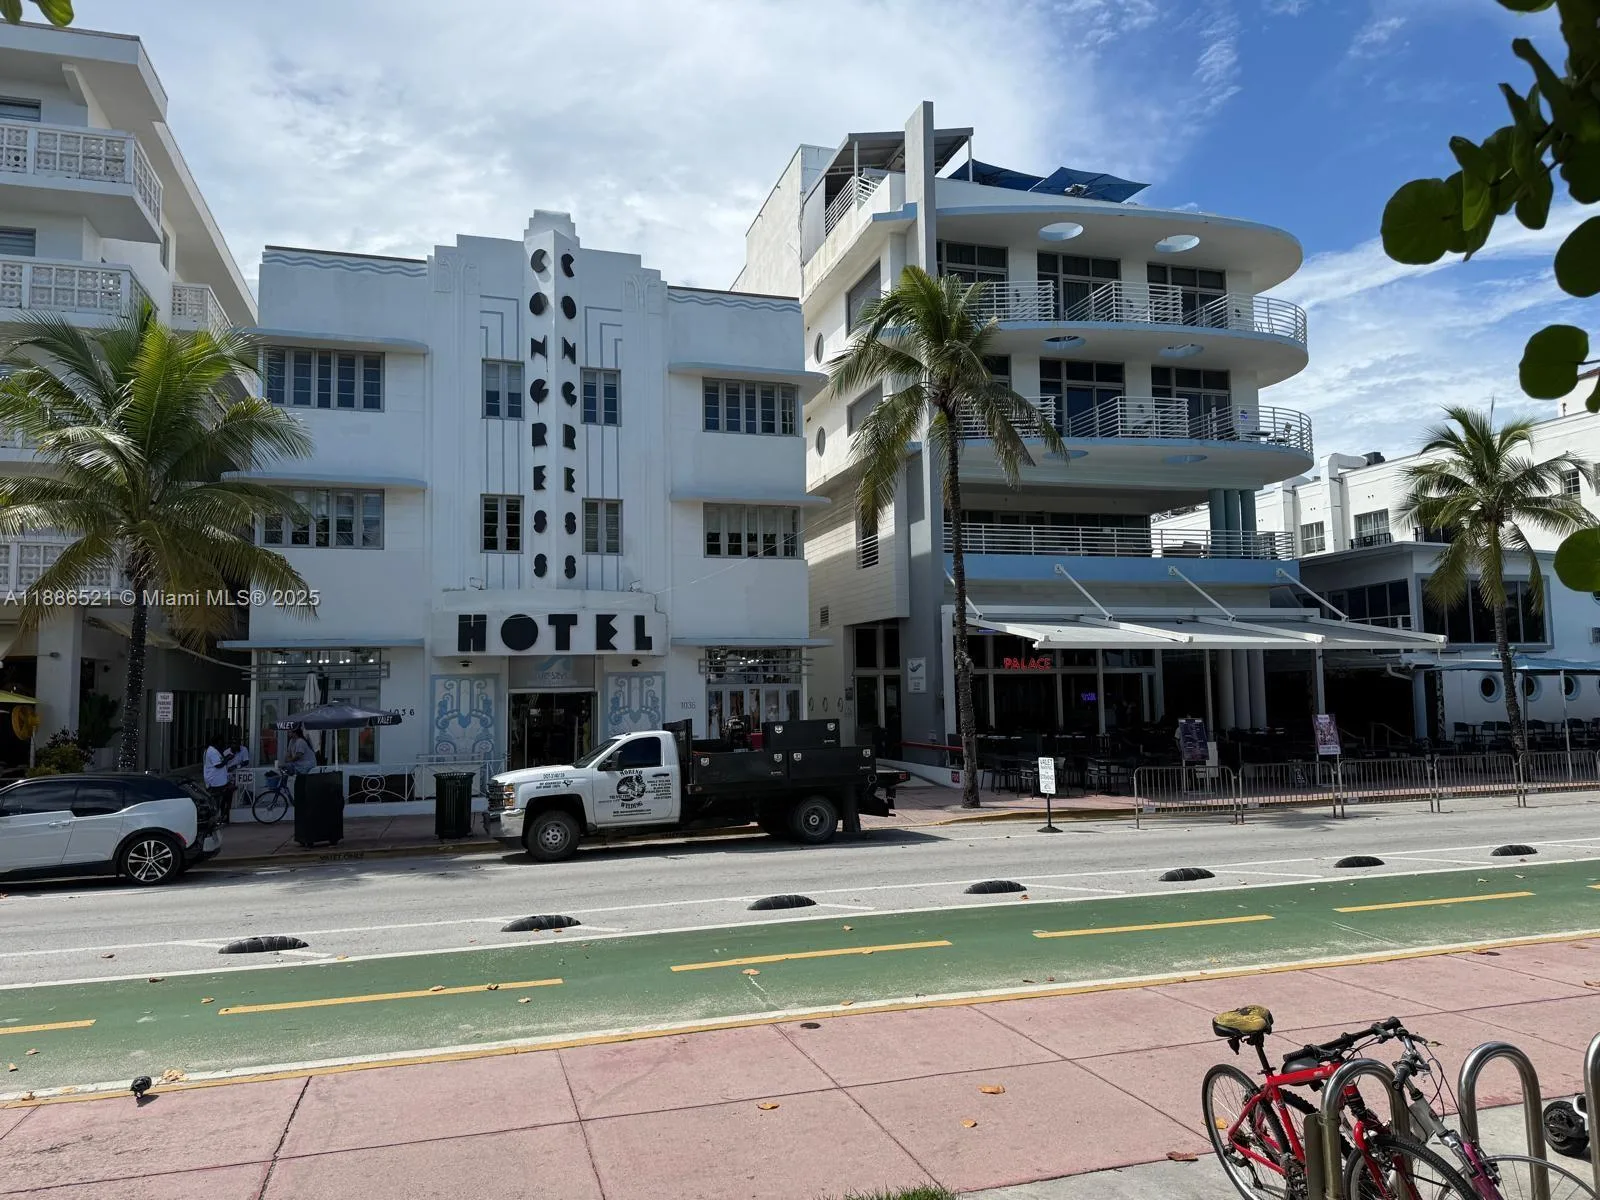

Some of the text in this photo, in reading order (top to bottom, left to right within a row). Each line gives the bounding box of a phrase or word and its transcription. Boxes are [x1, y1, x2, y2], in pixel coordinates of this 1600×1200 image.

[530, 248, 549, 578] CONGRESS
[561, 253, 577, 579] CONGRESS
[457, 613, 653, 652] HOTEL
[1003, 657, 1052, 671] PALACE
[681, 702, 696, 710] 1036
[276, 720, 295, 730] VALET
[378, 716, 393, 725] VALET
